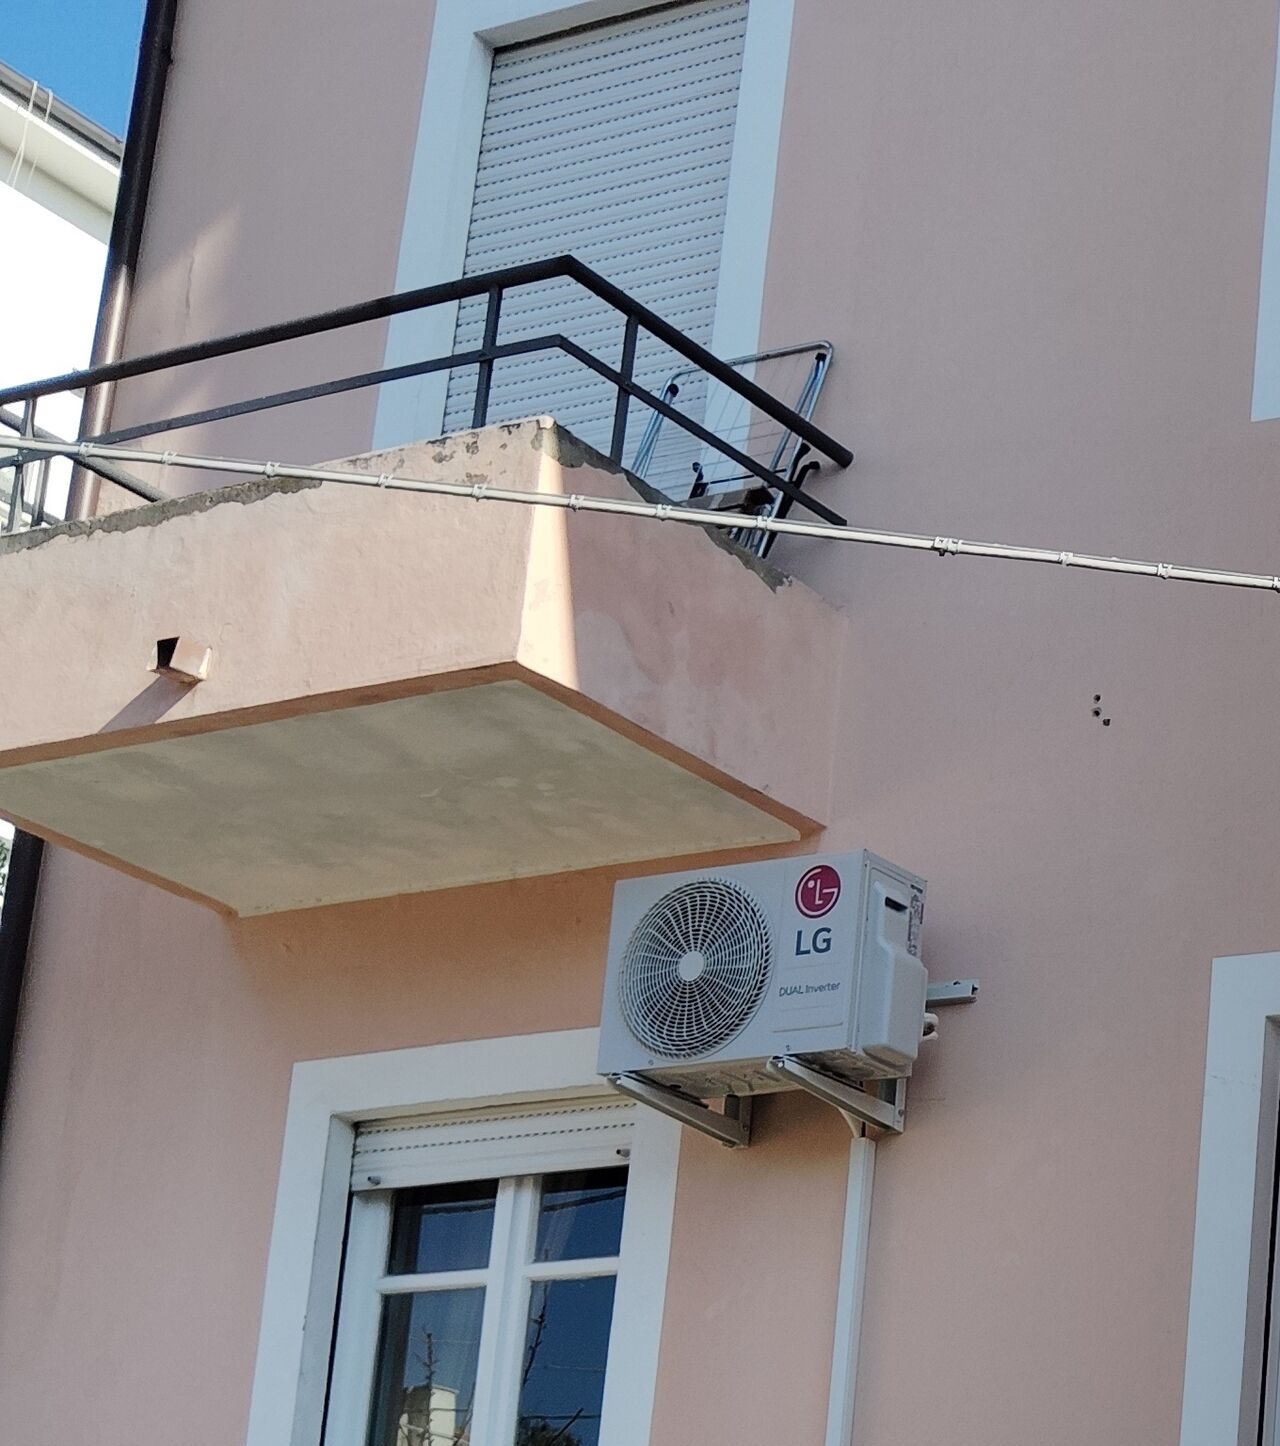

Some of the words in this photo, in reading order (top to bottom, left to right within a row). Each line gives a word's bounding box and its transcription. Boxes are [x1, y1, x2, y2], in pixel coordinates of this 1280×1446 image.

[795, 927, 832, 956] LG
[779, 984, 804, 997] DUAL
[805, 982, 841, 994] Inverter
